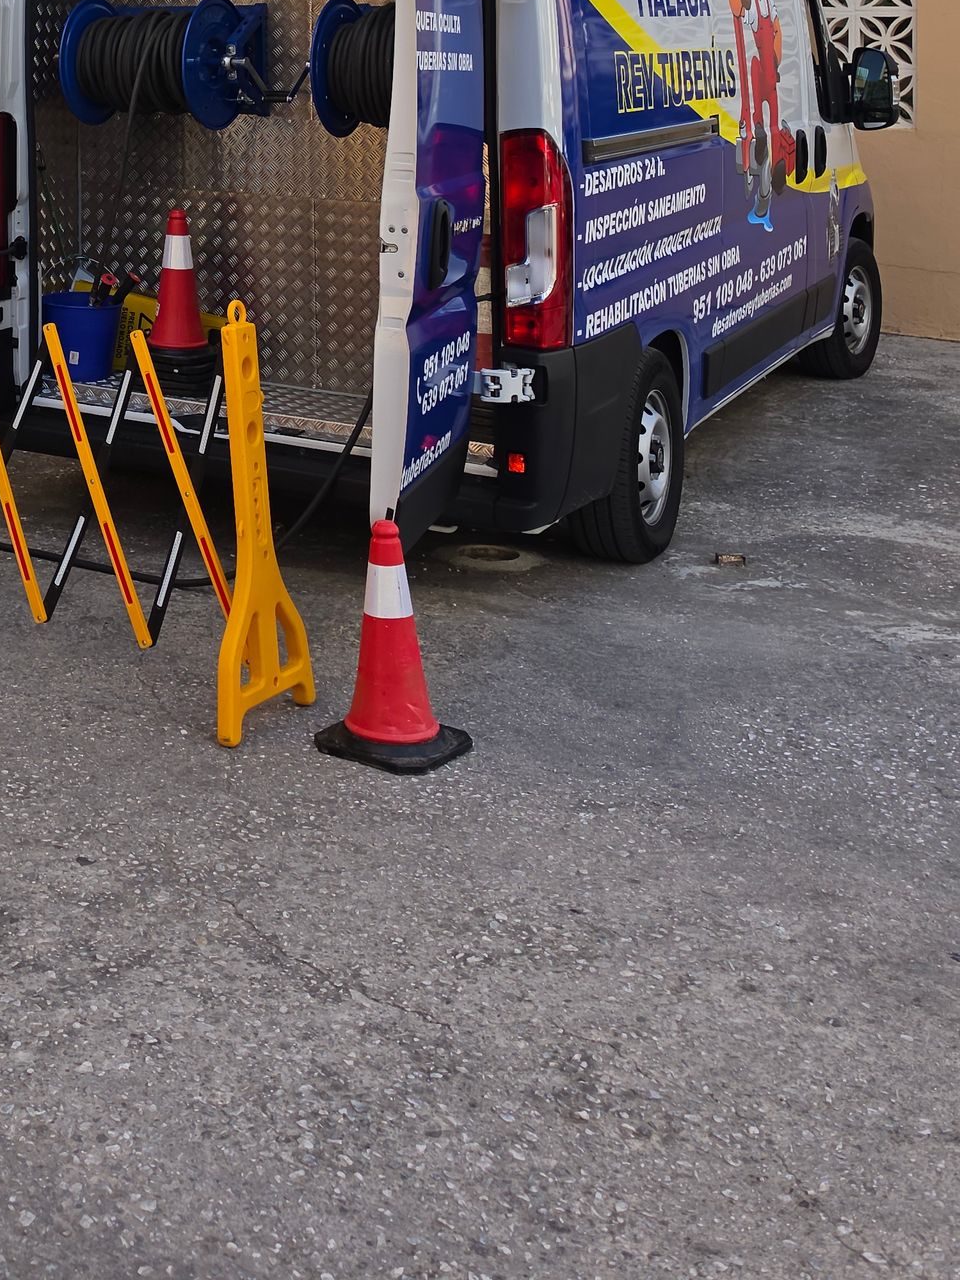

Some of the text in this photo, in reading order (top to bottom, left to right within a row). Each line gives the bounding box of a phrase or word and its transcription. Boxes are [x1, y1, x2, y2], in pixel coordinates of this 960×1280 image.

[416, 10, 461, 33] QUETA OCULTA
[416, 51, 473, 71] TUBERIAS SIN OBRA
[614, 32, 737, 113] REY TUBERÍAS
[645, 157, 656, 180] 24
[657, 156, 666, 176] h.
[585, 198, 646, 244] INSPECCIÓN
[648, 183, 706, 222] SANEAMIENTO
[654, 227, 692, 260] ARQUETA
[694, 215, 722, 242] OCULTA
[585, 278, 666, 339] REHABILITACIÓN
[667, 261, 706, 298] TUBERIAS
[707, 254, 720, 278] SIN
[722, 245, 741, 270] OBRA
[693, 291, 712, 324] 951
[716, 279, 734, 309] 109
[736, 268, 753, 297] 048
[760, 255, 776, 282] 639
[777, 245, 792, 271] 073
[793, 235, 807, 260] 061
[423, 331, 470, 381] 951 109 048
[421, 361, 469, 415] 639 073 061
